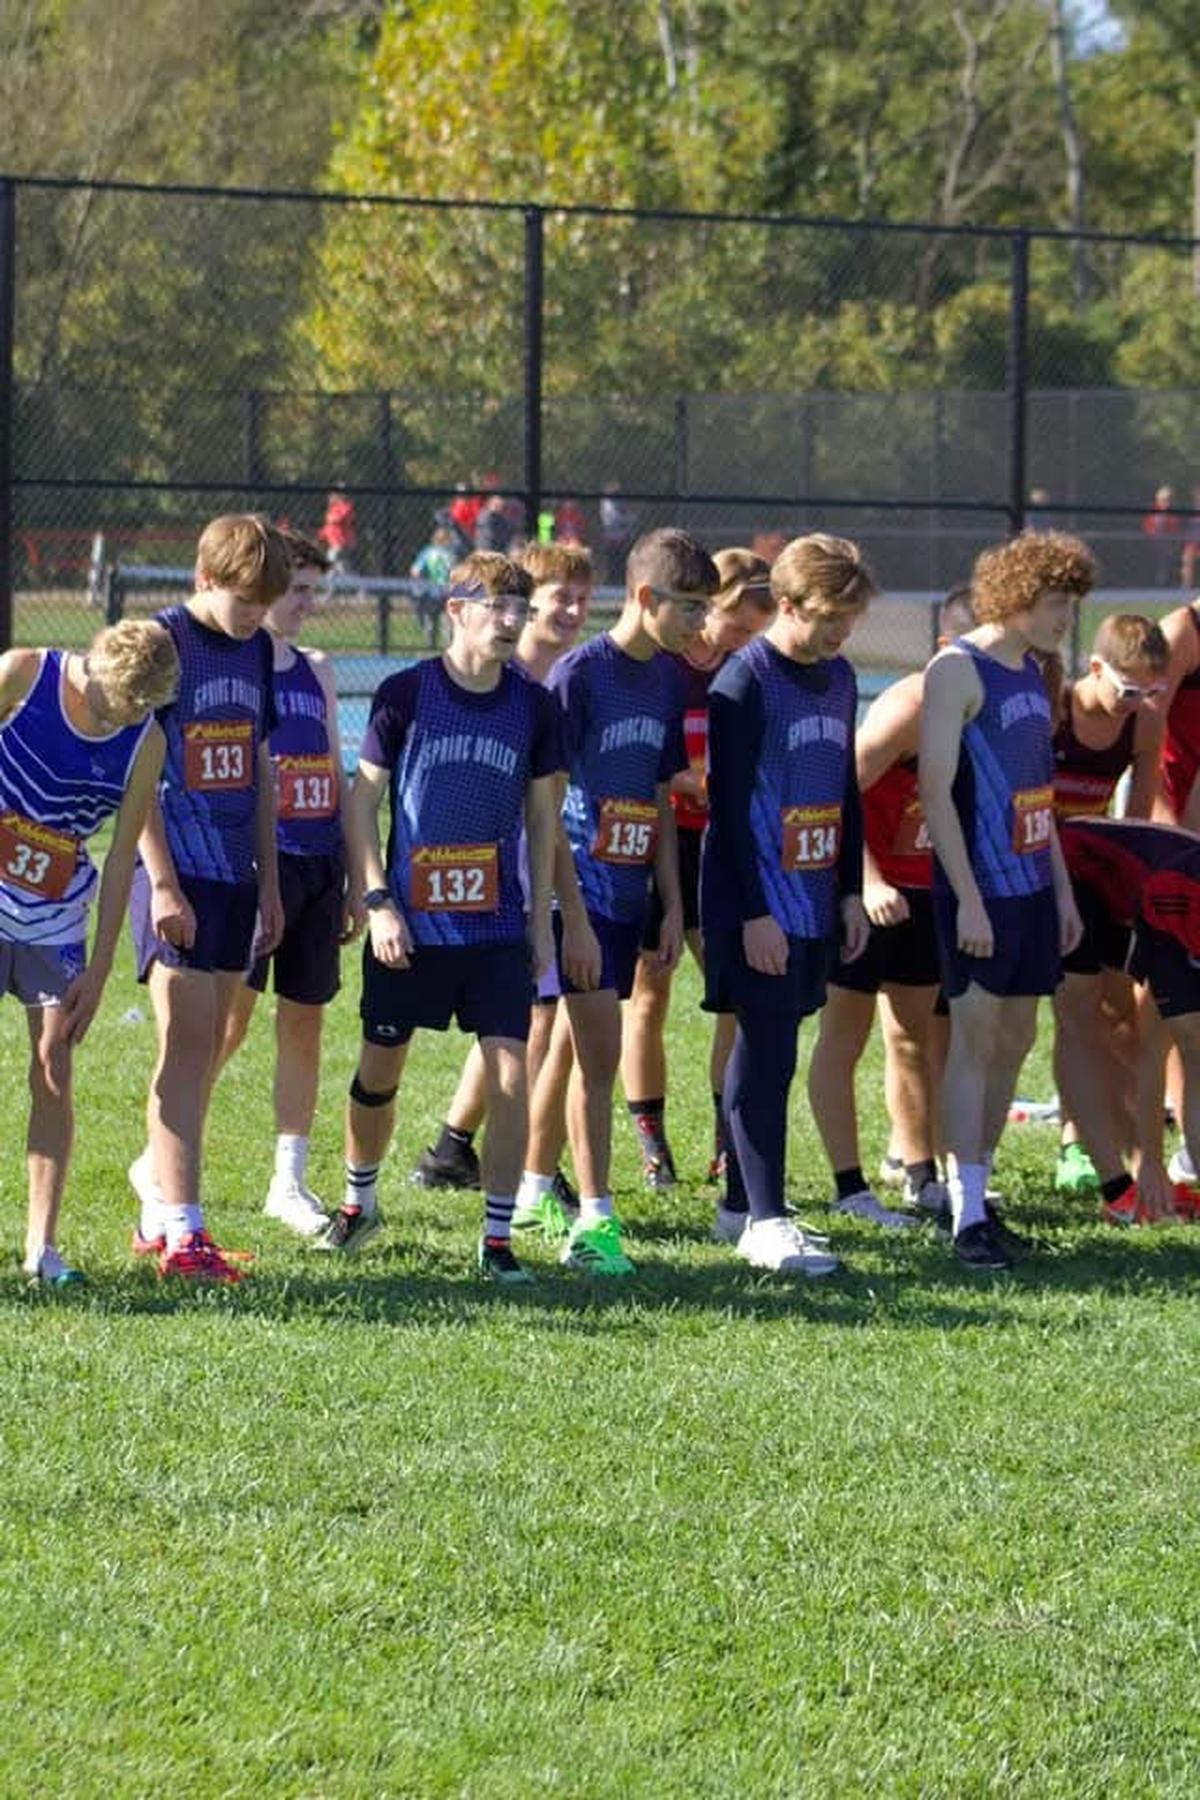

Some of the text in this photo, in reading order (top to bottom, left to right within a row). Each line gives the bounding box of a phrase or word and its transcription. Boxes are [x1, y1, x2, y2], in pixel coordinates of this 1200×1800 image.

[201, 744, 244, 780] 133
[293, 776, 330, 810] 131
[607, 821, 653, 856] 135
[796, 826, 836, 862] 134
[7, 844, 51, 884] 33
[427, 867, 486, 904] 132
